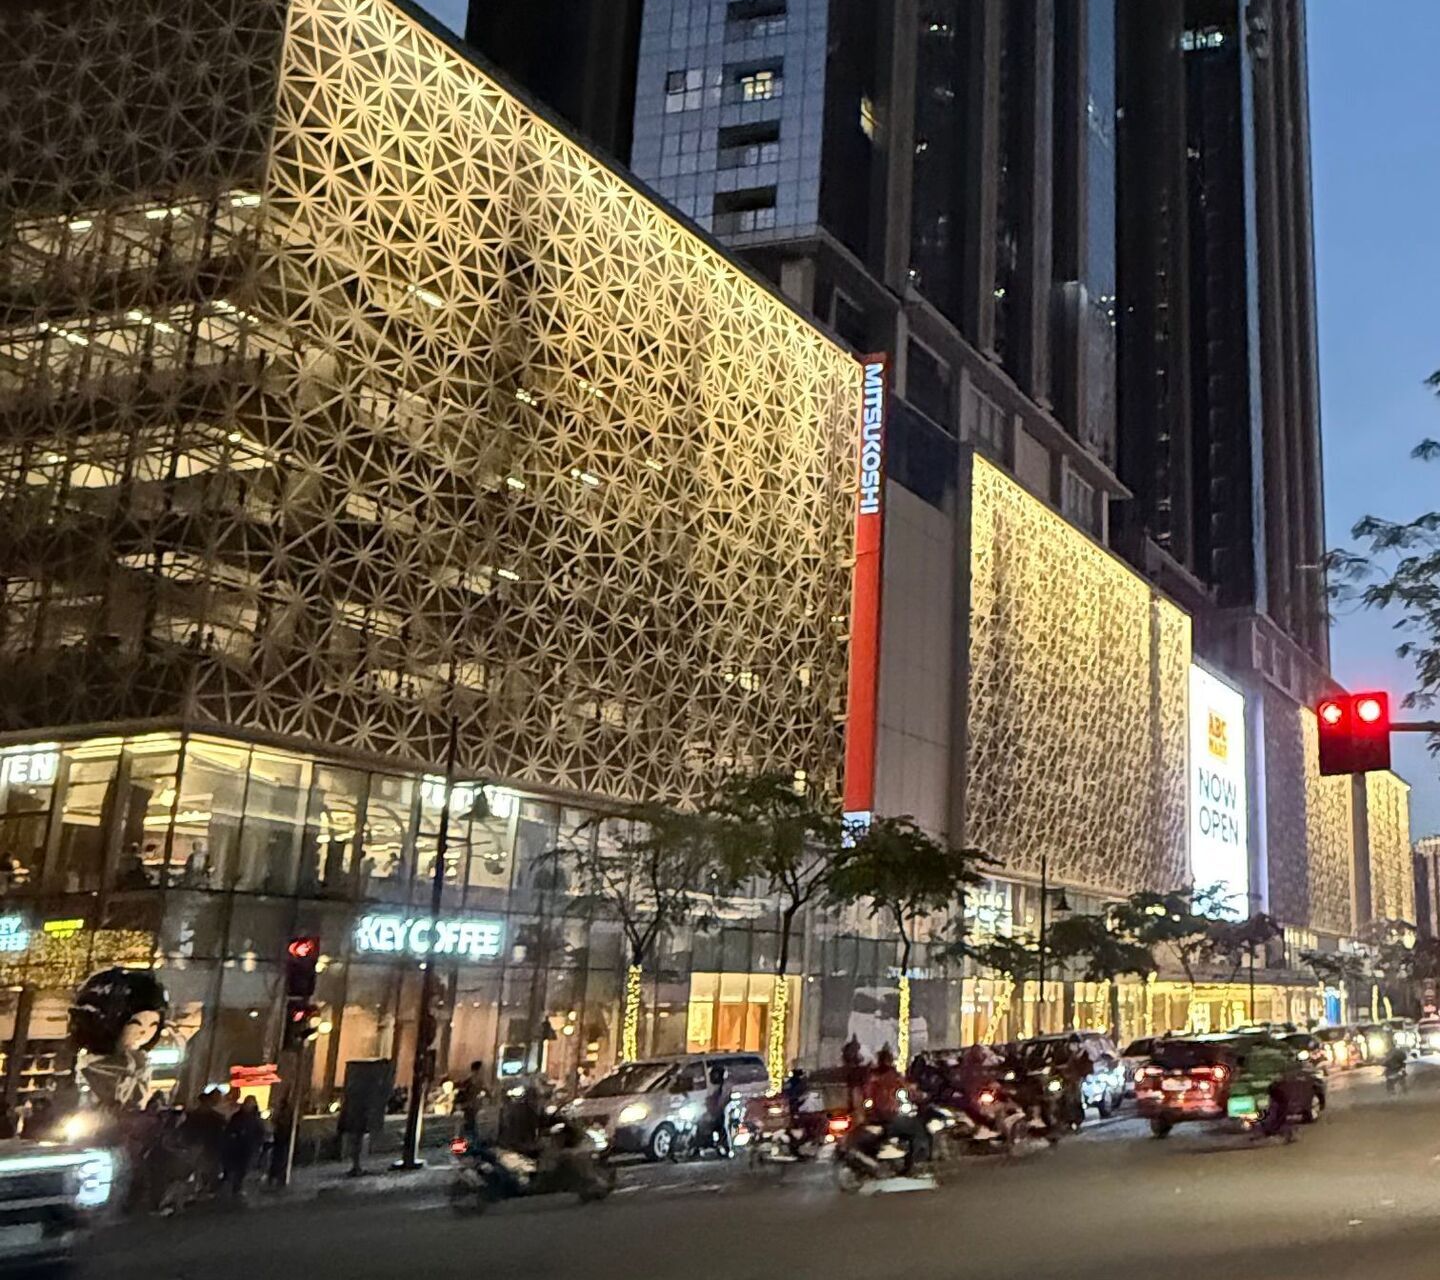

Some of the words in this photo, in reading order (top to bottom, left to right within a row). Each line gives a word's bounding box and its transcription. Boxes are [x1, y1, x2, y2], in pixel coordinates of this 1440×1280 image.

[860, 362, 884, 514] MITSUKOSHI
[1208, 713, 1227, 741] ABC
[1199, 767, 1237, 810] NOW
[1199, 805, 1239, 846] OPEN
